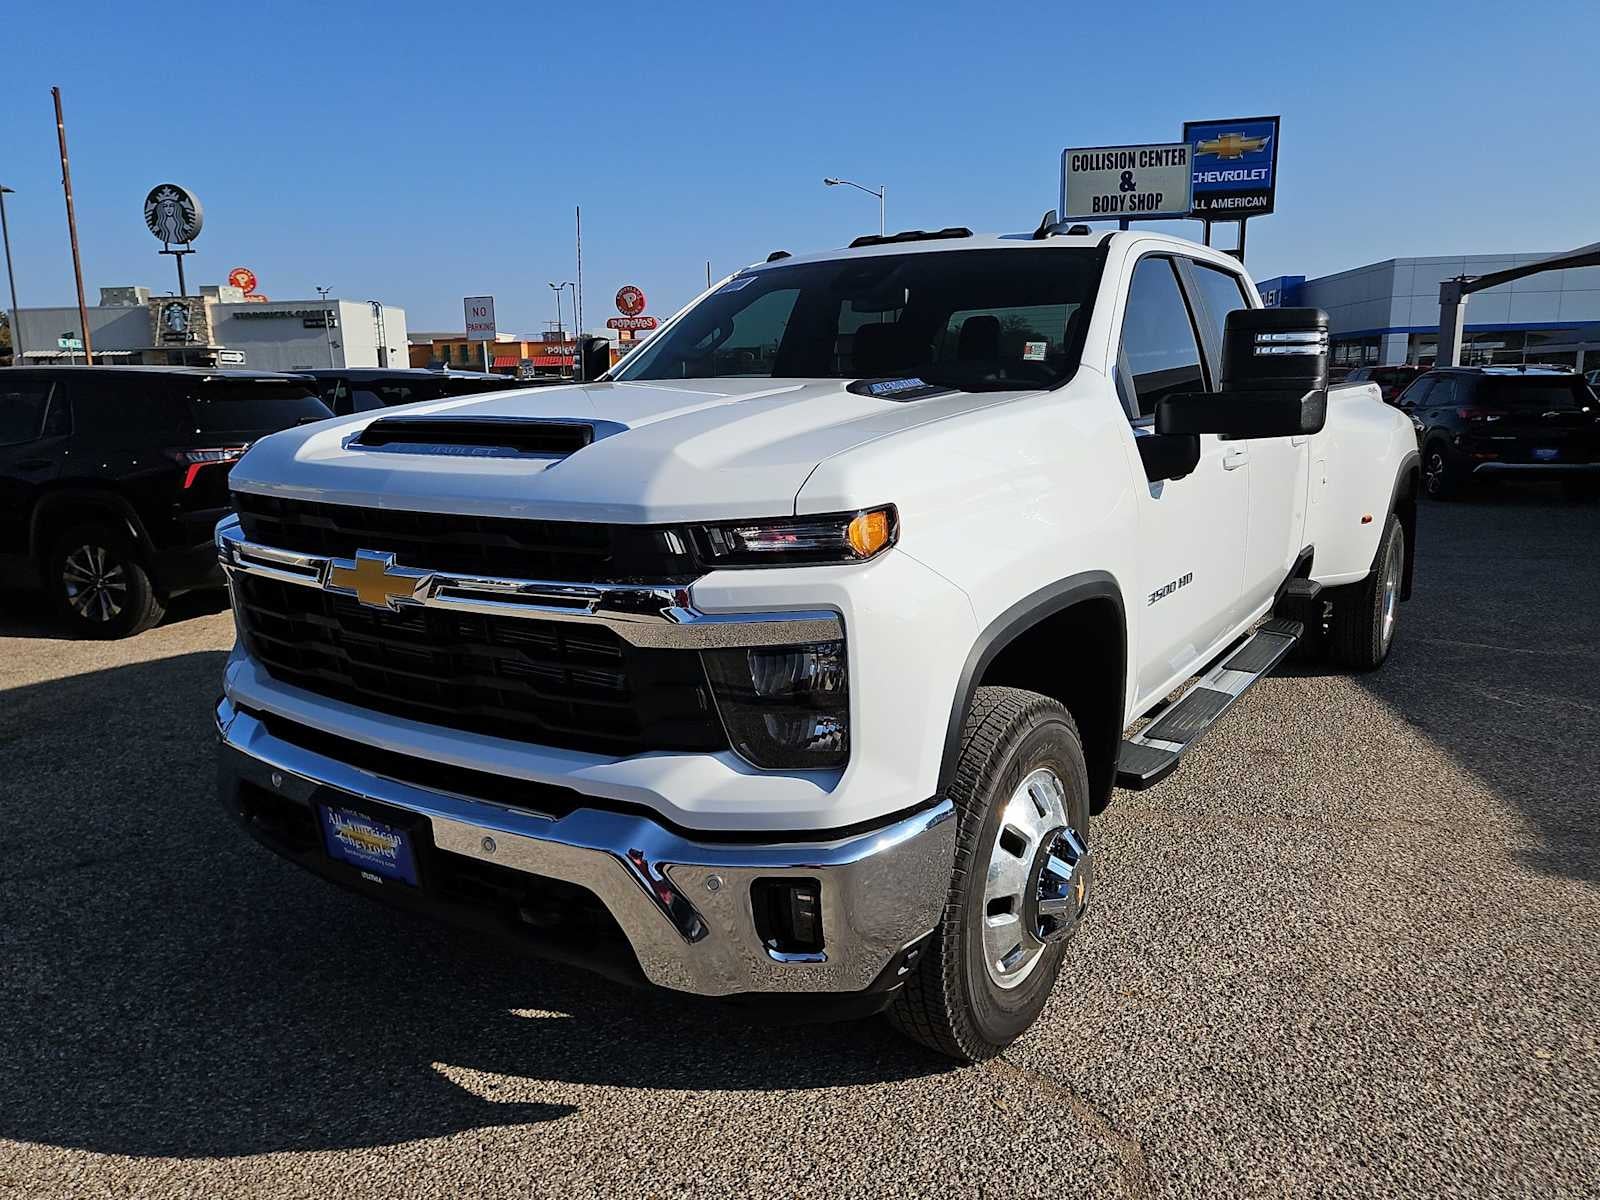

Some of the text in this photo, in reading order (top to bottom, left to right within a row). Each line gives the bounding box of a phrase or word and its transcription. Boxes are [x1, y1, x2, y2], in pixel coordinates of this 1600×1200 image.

[1072, 148, 1187, 172] COLLISION CENTER
[1119, 170, 1137, 192] &
[1192, 168, 1268, 184] CHEVROLET
[1092, 193, 1163, 213] BODY SHOP
[1210, 197, 1267, 210] AMERICAN
[472, 306, 487, 317] NO
[467, 321, 495, 331] PARKING
[523, 368, 534, 376] 35
[1147, 572, 1193, 607] 3500 HD
[328, 812, 342, 825] All
[346, 818, 402, 846] American
[335, 831, 396, 859] Chevrolet
